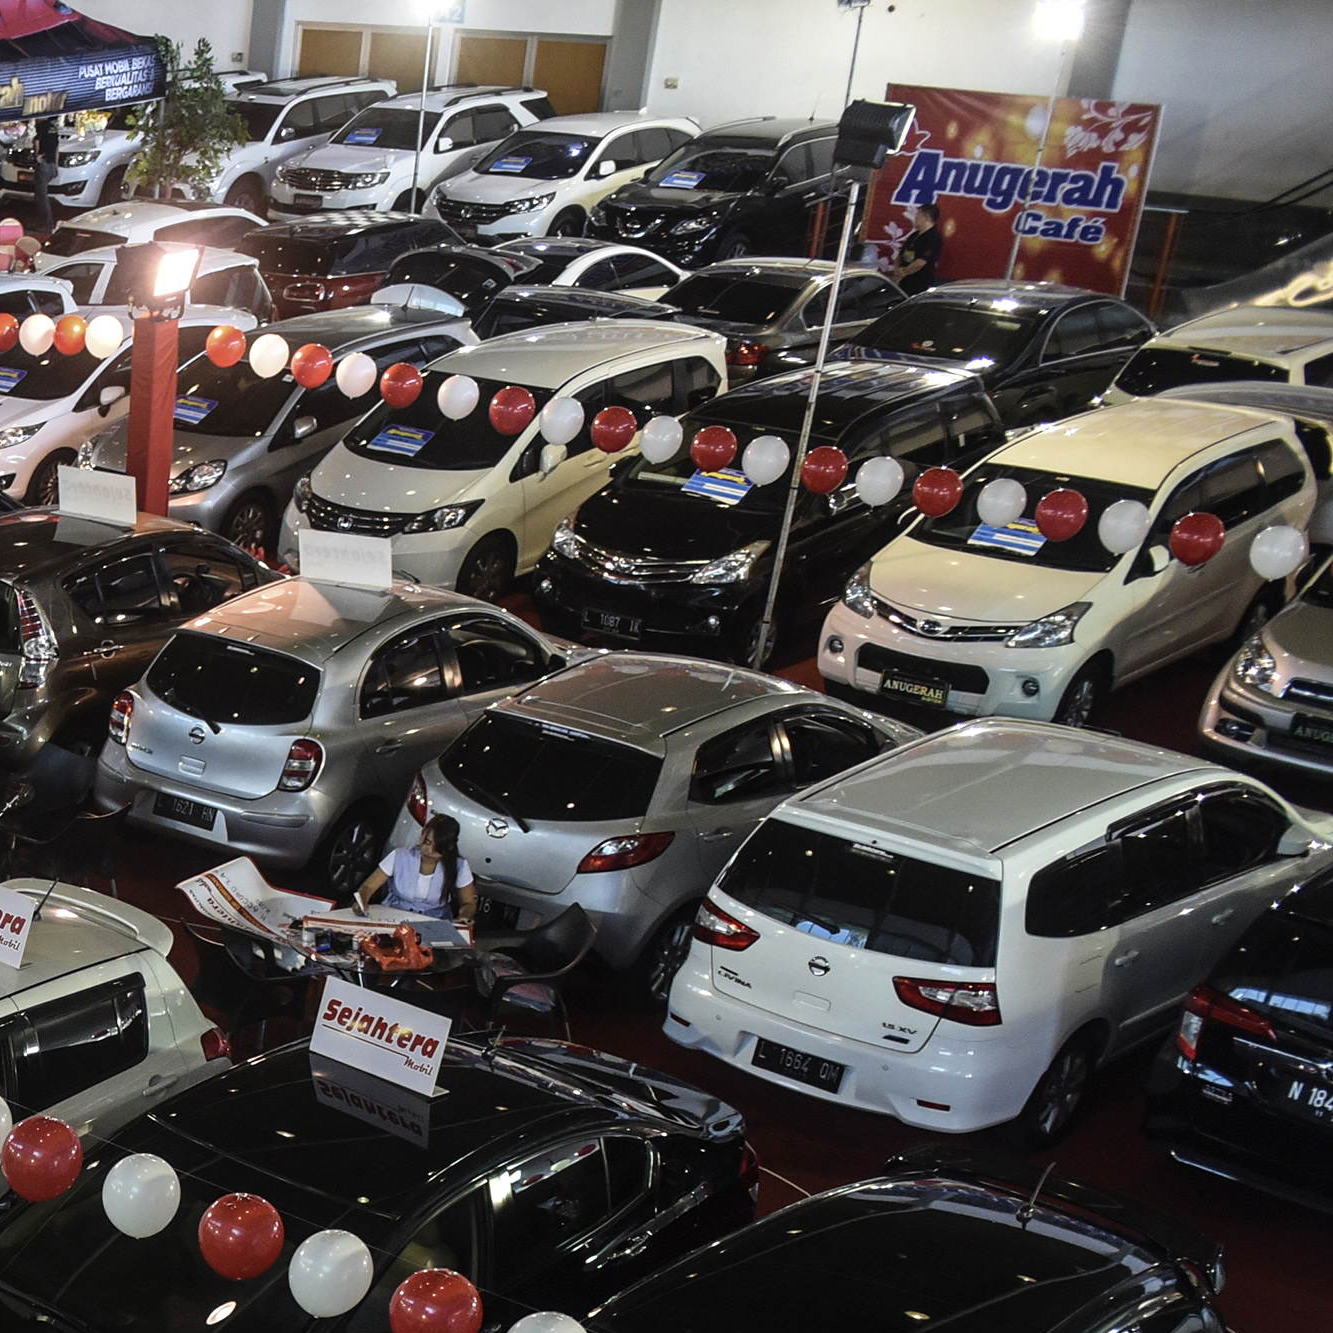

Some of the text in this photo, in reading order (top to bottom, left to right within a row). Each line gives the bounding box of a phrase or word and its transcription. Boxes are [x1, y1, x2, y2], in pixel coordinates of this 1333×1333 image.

[79, 65, 104, 79] PUSAT
[105, 60, 130, 75] MOBIL
[890, 148, 1127, 213] Anugerah
[1013, 211, 1108, 244] Café
[883, 679, 944, 700] ANUGERAH
[717, 970, 752, 989] LIVINA
[322, 998, 440, 1059] Sejahtera
[404, 1056, 433, 1076] Mobil
[758, 1042, 766, 1058] L
[779, 1048, 812, 1074] 1664
[1288, 1081, 1304, 1100] N
